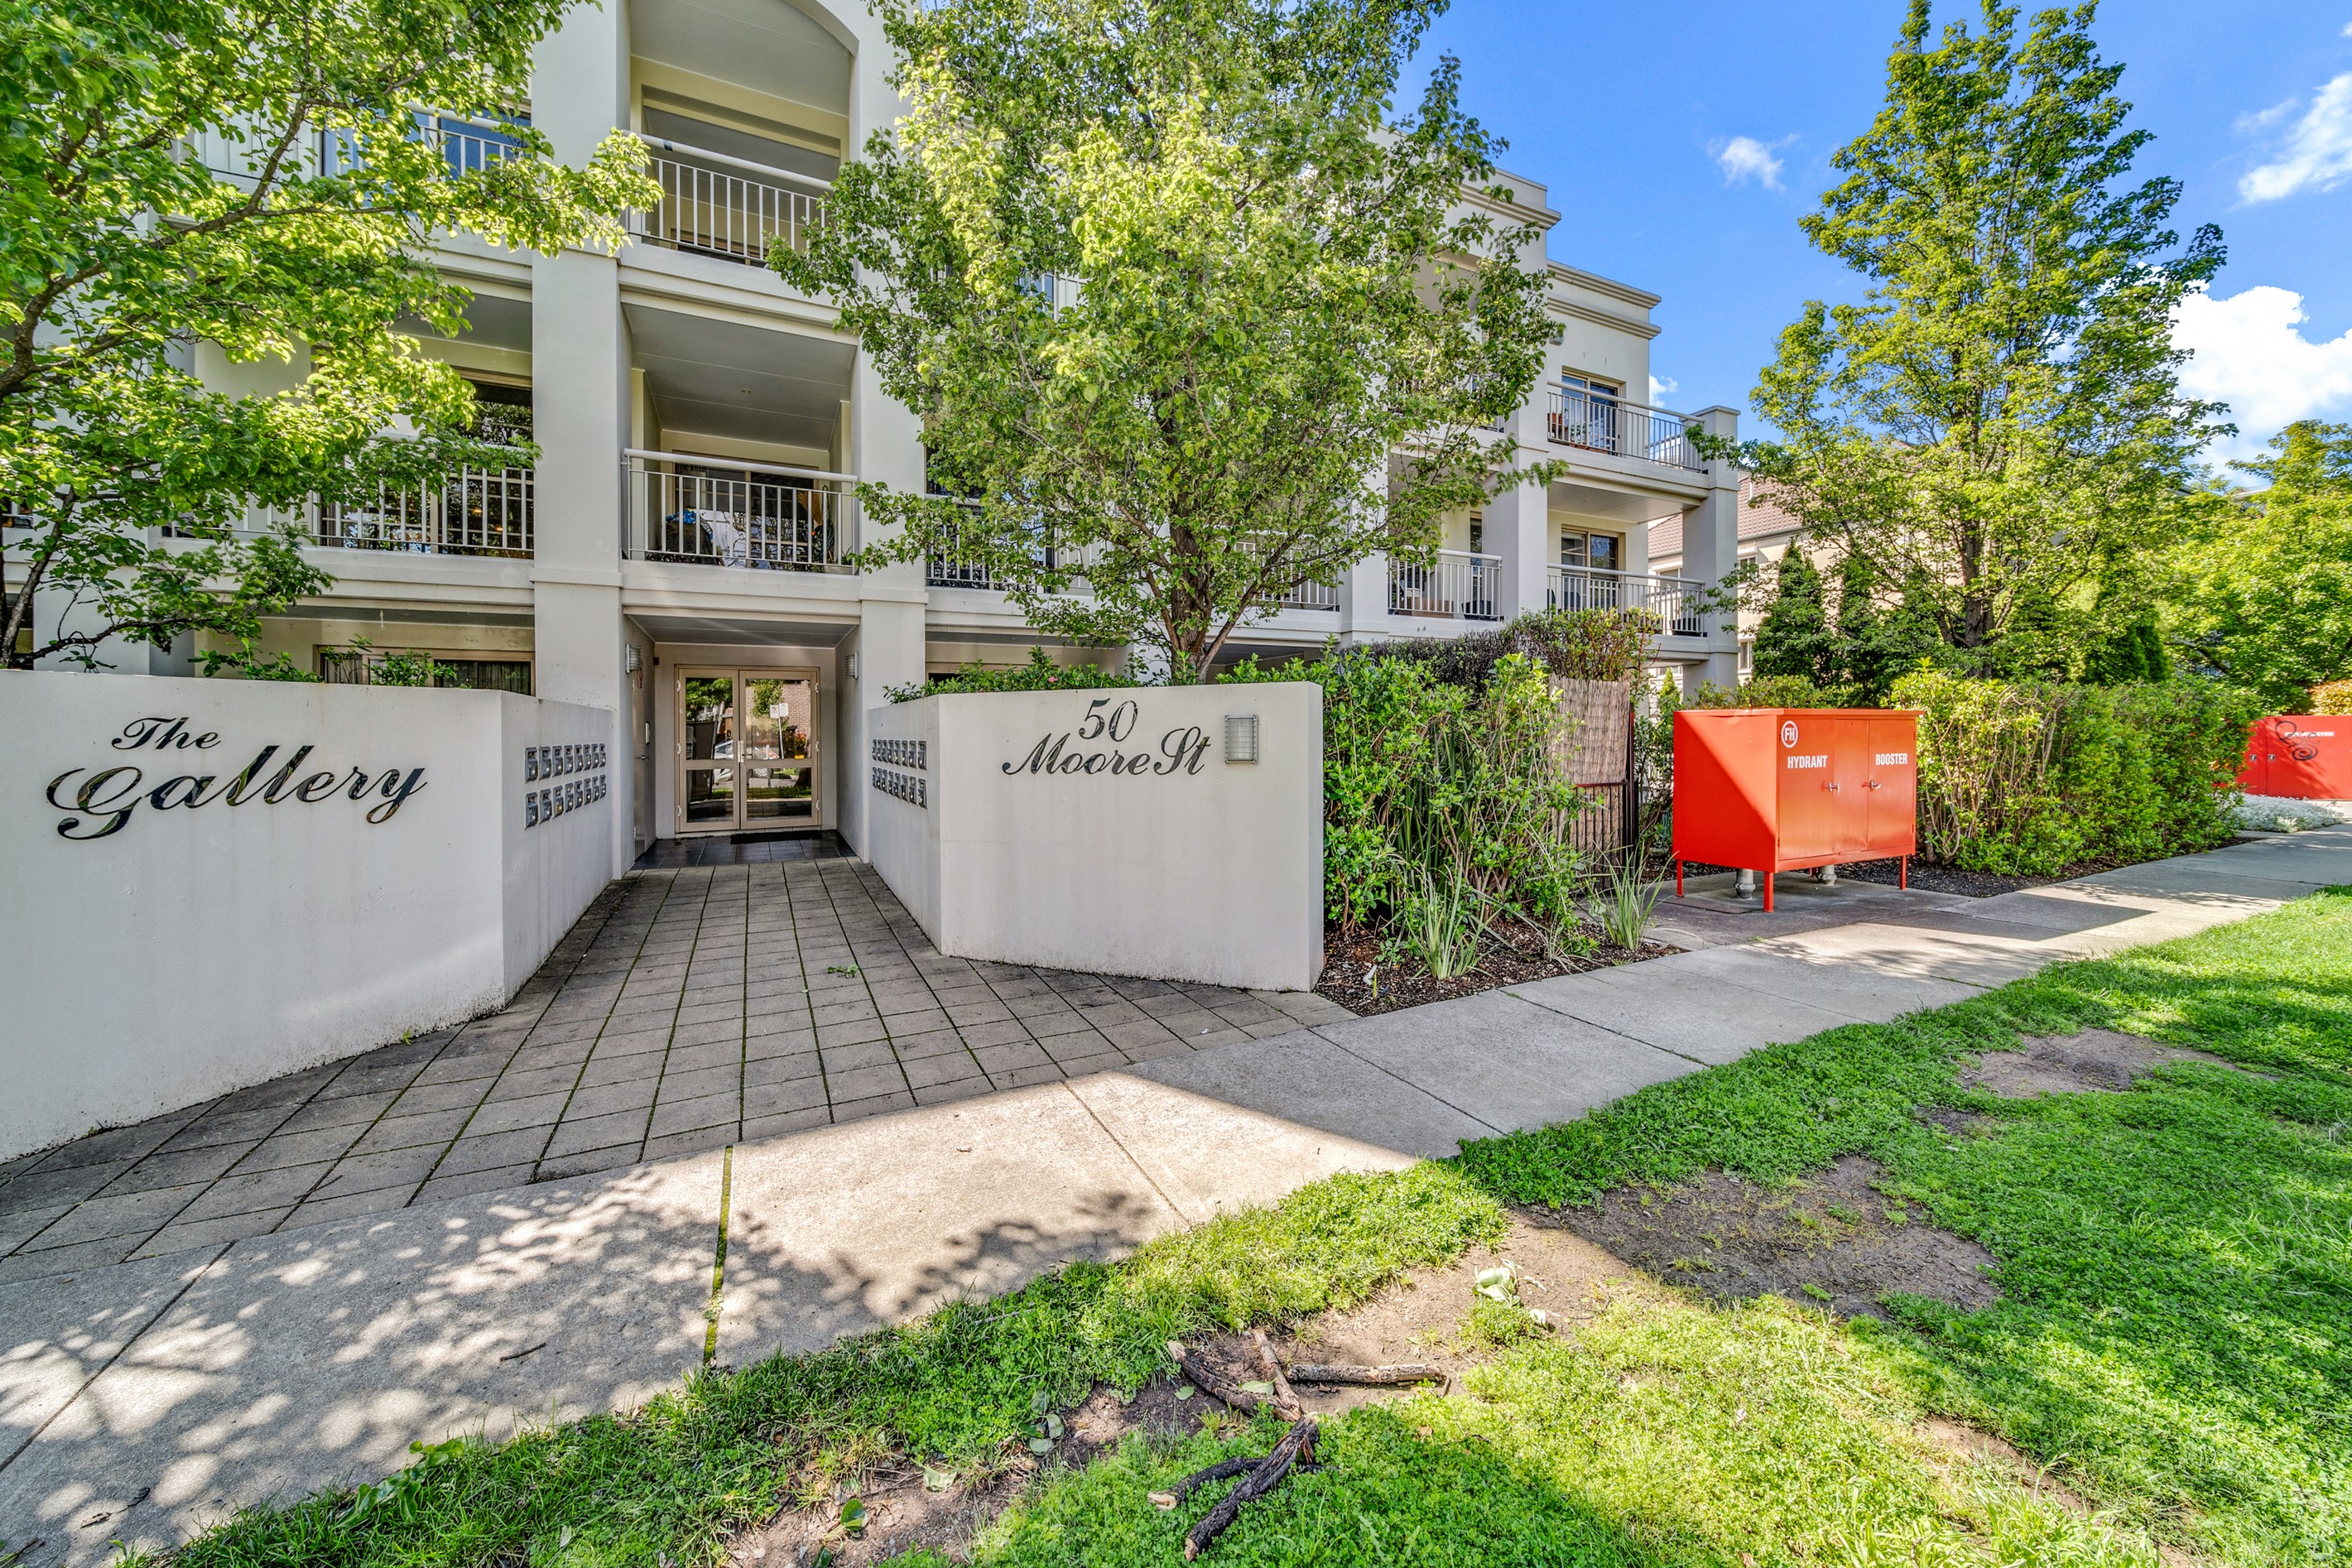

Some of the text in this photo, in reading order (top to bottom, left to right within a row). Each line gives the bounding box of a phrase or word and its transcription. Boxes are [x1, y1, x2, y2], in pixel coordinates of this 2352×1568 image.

[111, 717, 221, 750] The
[1079, 698, 1138, 742] 50
[1002, 726, 1211, 776] Moore St
[1787, 755, 1828, 769] HYDRANT
[1875, 753, 1908, 766] BOOSTER
[46, 745, 428, 840] Gallery
